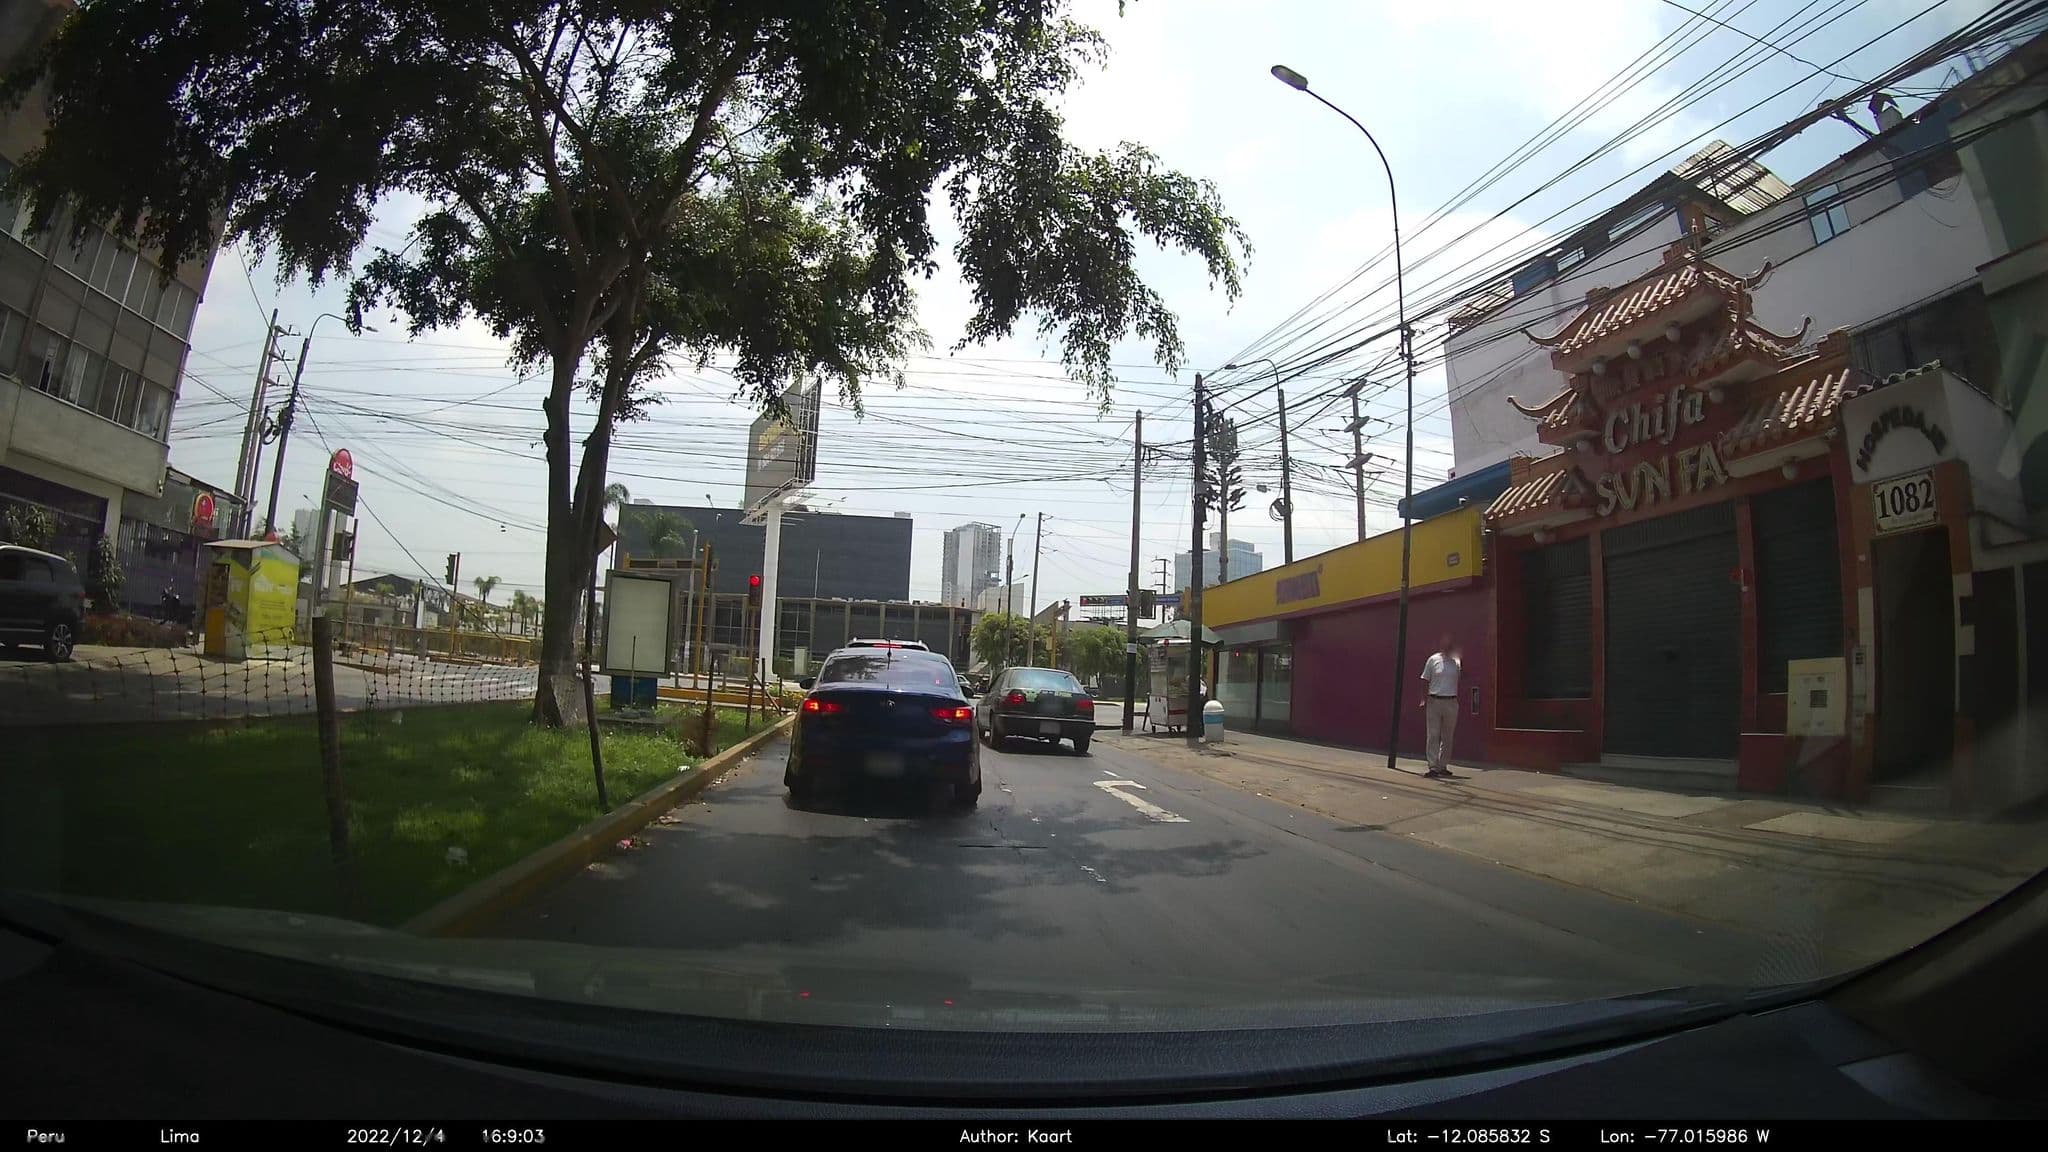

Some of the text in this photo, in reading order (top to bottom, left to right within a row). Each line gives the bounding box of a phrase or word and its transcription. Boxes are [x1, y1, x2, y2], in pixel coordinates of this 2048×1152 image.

[1604, 384, 1705, 454] Chifa
[1675, 441, 1729, 497] FA
[1876, 478, 1935, 519] 1082
